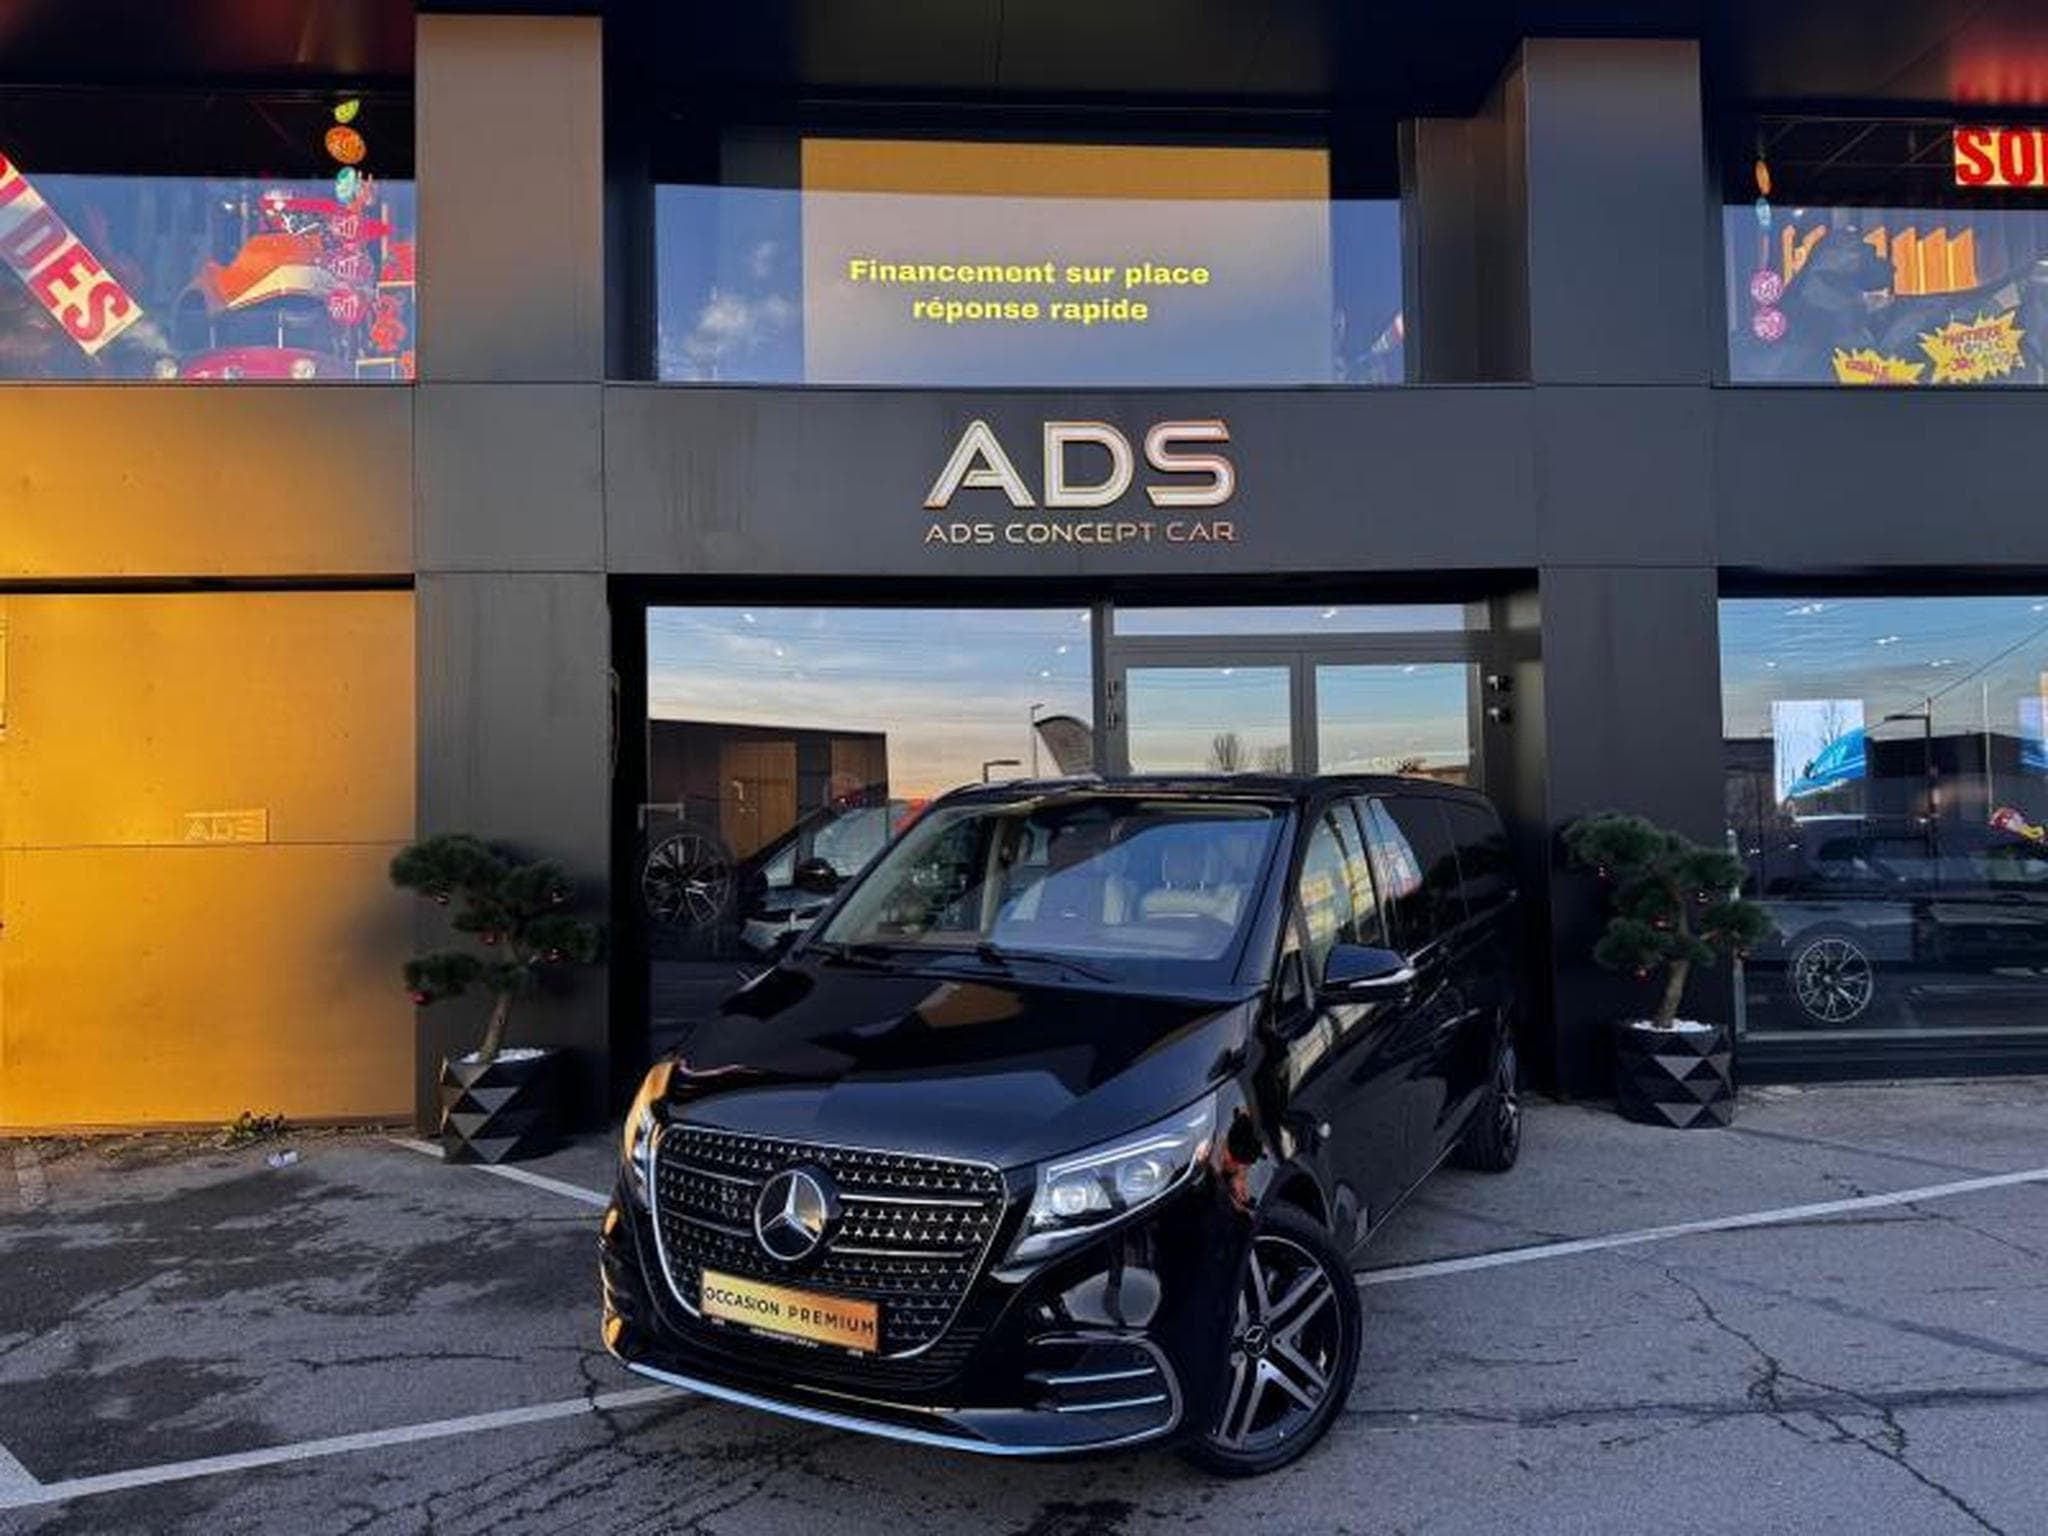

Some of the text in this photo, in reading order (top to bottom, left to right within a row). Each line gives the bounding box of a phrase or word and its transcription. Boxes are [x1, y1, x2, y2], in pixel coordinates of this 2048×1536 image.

[1956, 127, 2048, 187] SO
[850, 260, 1210, 288] Financement sur place
[913, 296, 1147, 324] réponse rapide
[923, 419, 1235, 508] ADS
[925, 521, 1235, 543] ADS CONCEPT CAR
[703, 1286, 875, 1336] OCCASION PREMIUM
